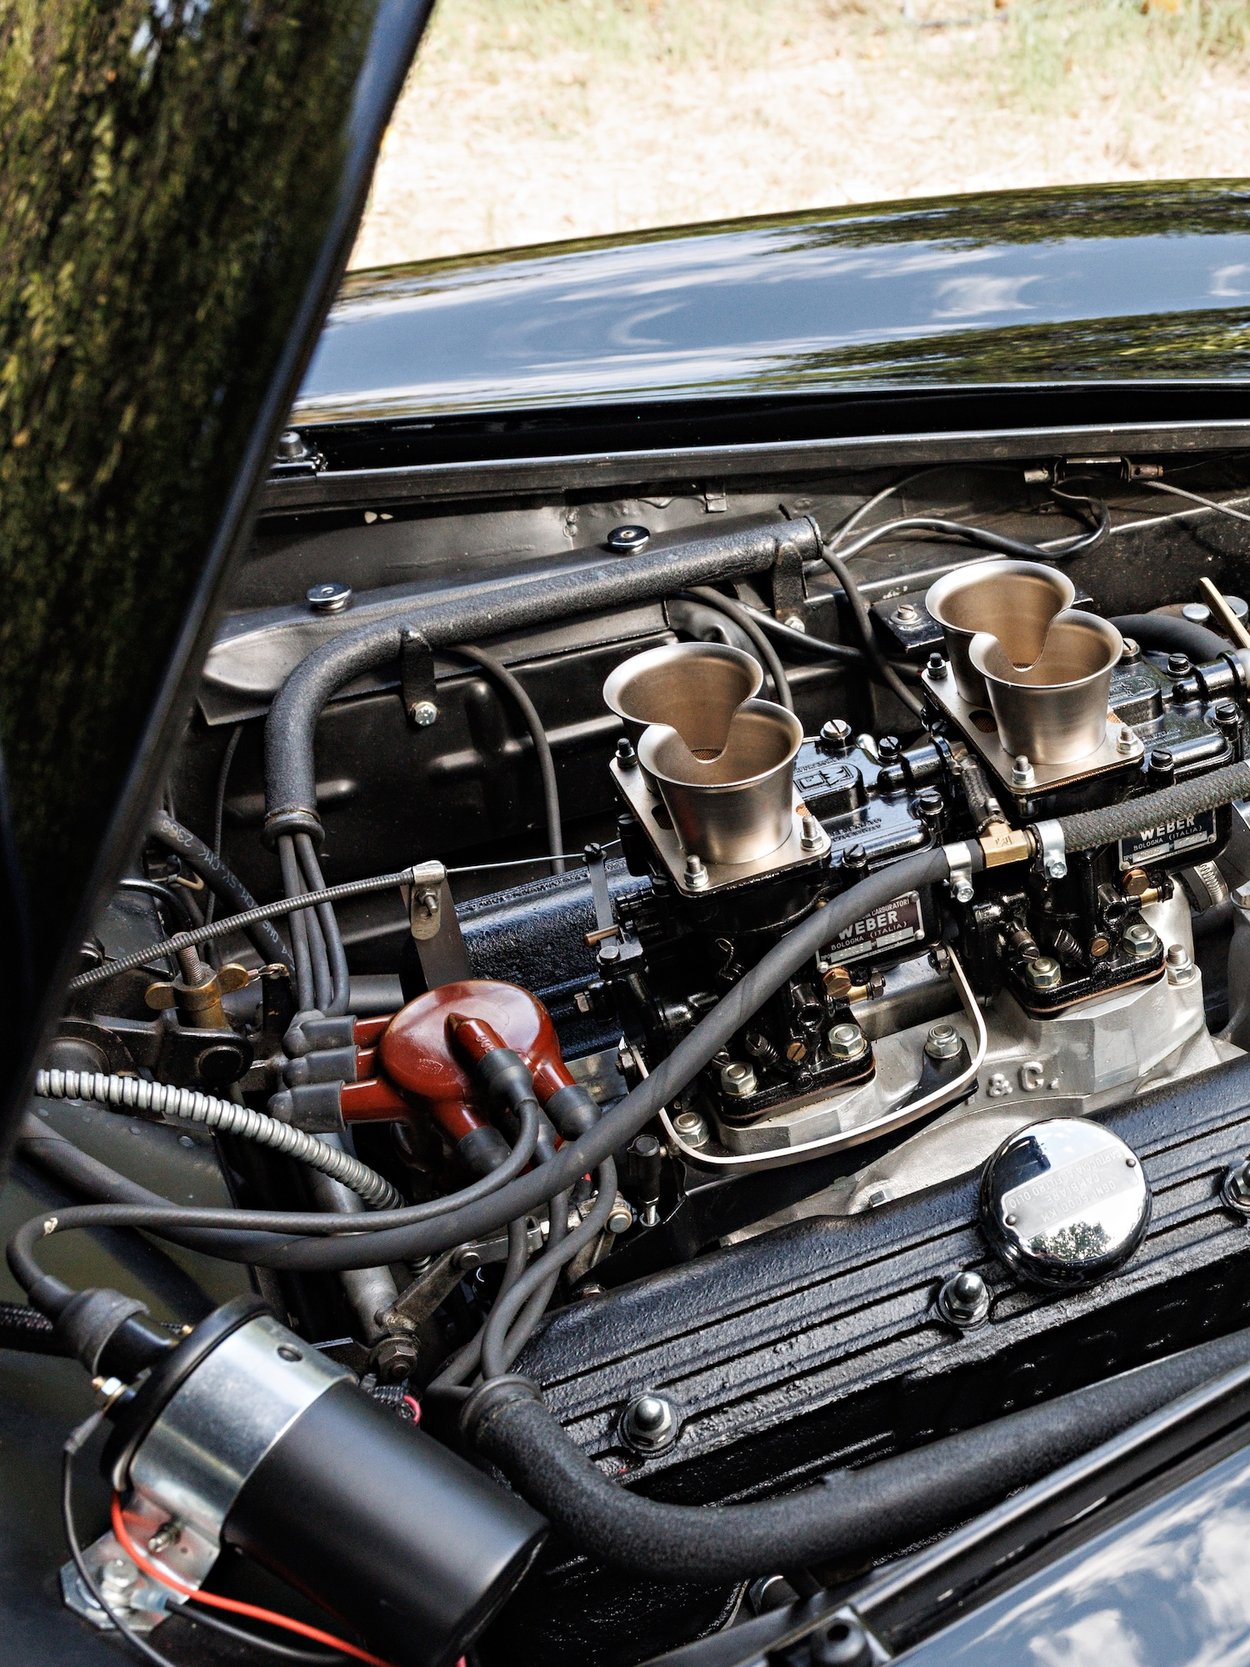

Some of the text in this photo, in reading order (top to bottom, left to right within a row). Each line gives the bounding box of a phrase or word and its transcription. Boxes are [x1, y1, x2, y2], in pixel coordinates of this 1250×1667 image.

[1133, 838, 1164, 851] BOLOGNA
[1168, 825, 1203, 842] (ITALIA)
[1140, 815, 1196, 841] WEBER
[871, 898, 910, 917] CARBURATORI
[831, 936, 864, 951] BOLOGNA
[869, 920, 907, 939] (ITALIA)
[838, 911, 898, 941] WEBER
[1032, 1176, 1063, 1196] FILTRO
[1047, 1173, 1100, 1204] CAMBIARE
[1092, 1180, 1117, 1200] OGNI
[1009, 1191, 1032, 1209] OLIO
[1041, 1207, 1058, 1224] KM
